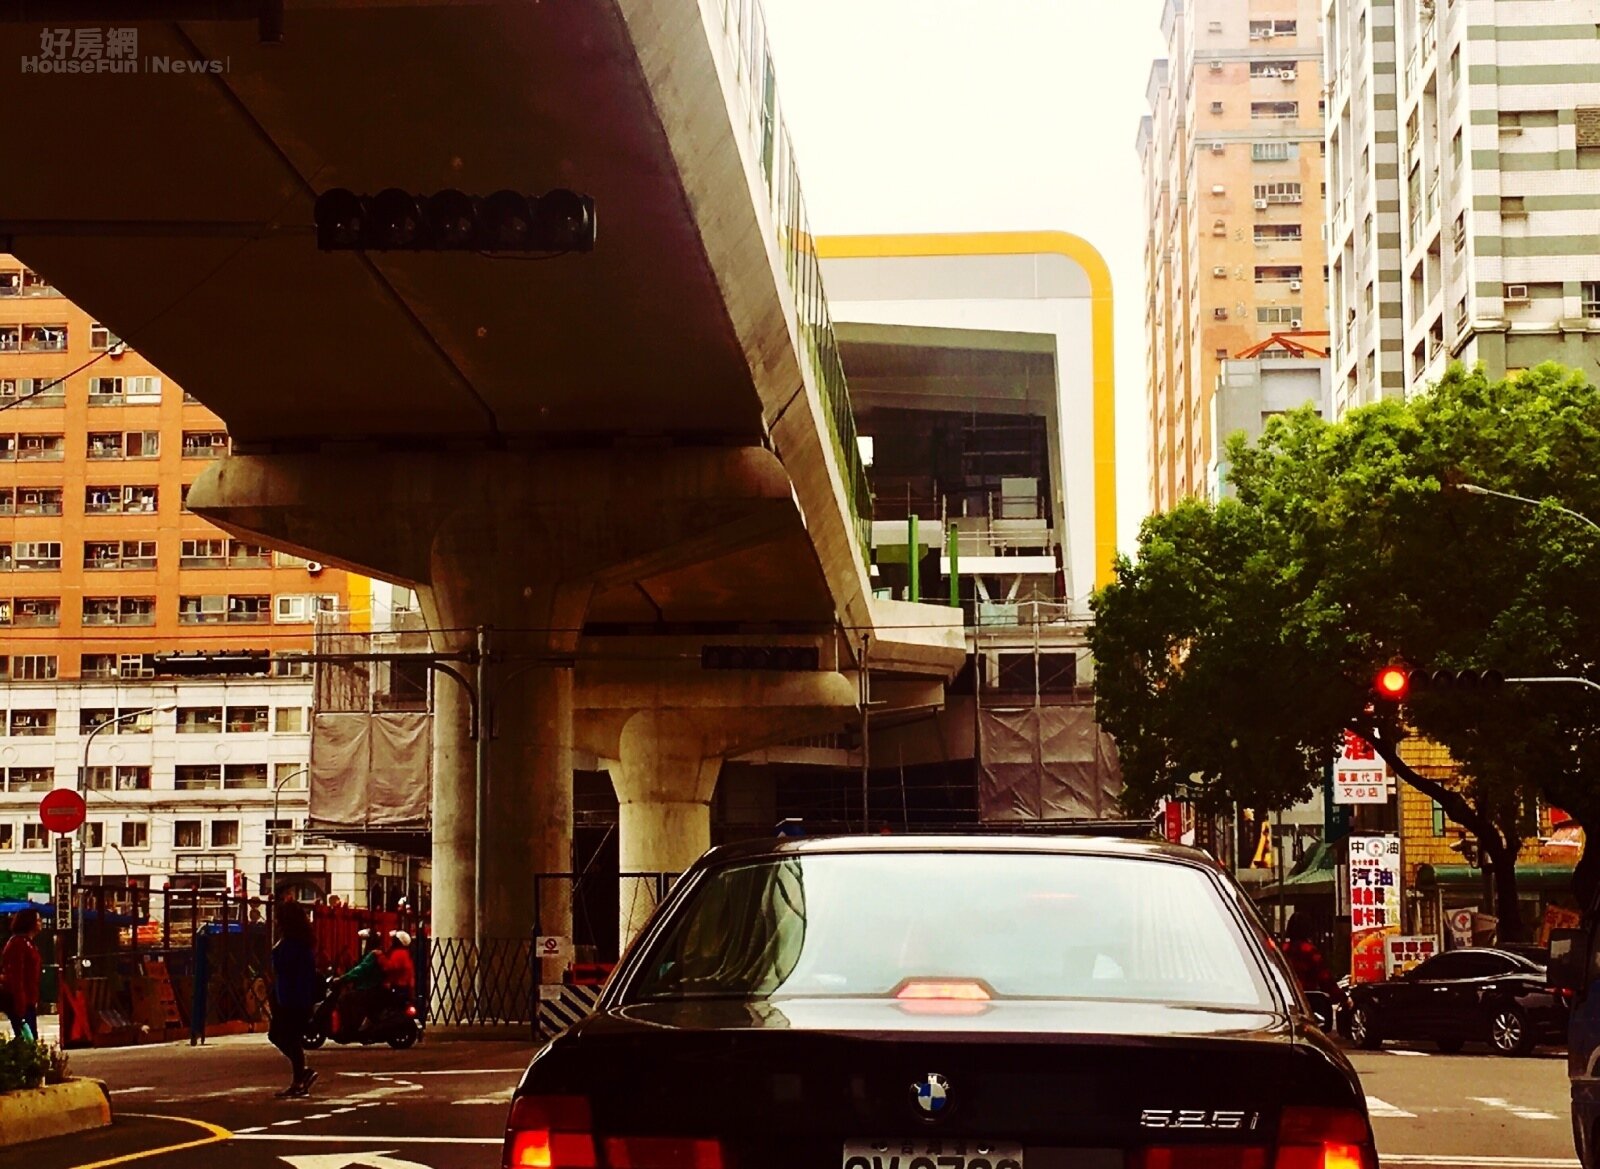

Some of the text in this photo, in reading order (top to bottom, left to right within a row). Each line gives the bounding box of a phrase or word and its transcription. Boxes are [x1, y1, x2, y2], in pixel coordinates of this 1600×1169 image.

[1343, 786, 1379, 797] 文心店
[1351, 868, 1394, 886] 汽油
[1140, 1109, 1260, 1130] 525i
